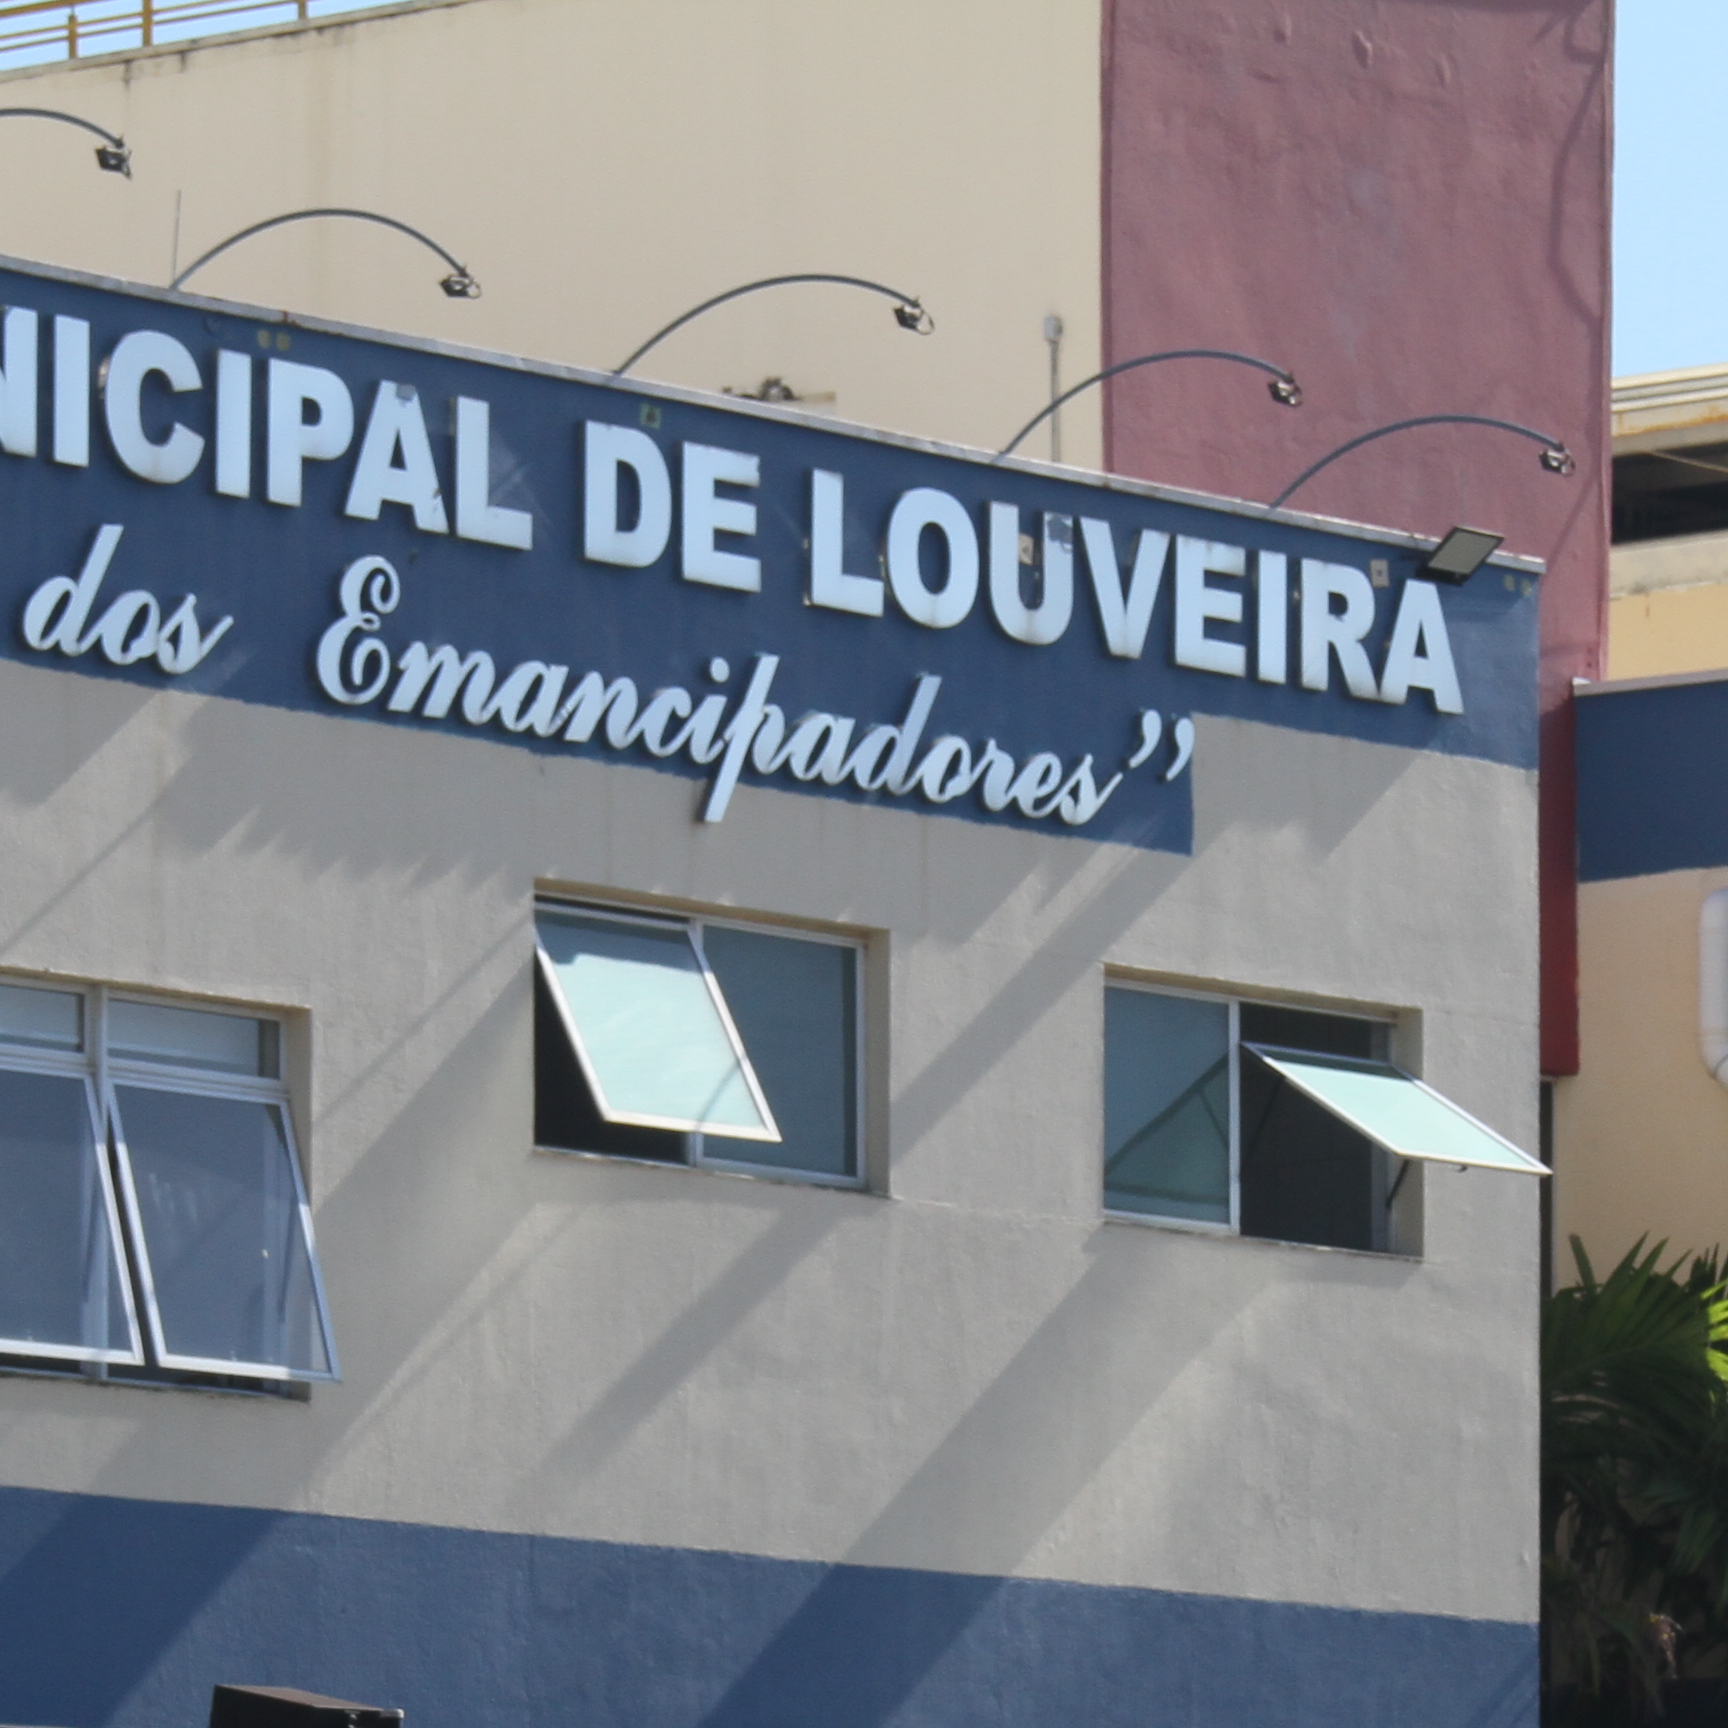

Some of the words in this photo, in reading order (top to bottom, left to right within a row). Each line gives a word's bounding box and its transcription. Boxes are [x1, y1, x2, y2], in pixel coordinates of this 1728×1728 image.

[23, 525, 233, 674] dos
[582, 420, 761, 592] DE
[808, 469, 1464, 715] LOUVEIRA
